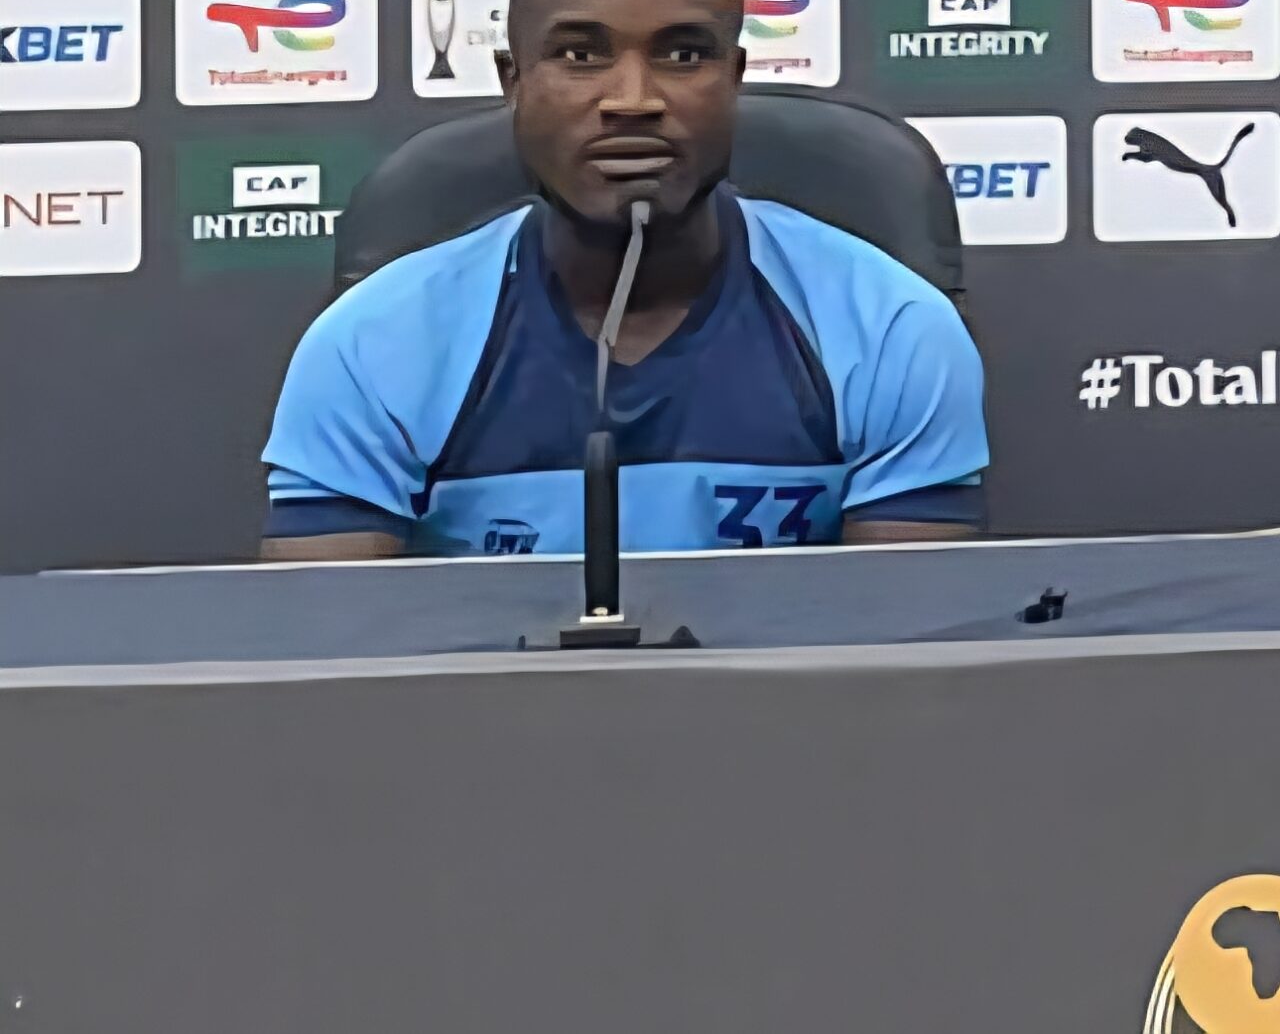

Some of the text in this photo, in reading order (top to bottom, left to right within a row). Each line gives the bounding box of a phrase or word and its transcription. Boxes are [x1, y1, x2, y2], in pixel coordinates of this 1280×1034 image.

[889, 30, 1050, 58] INTEGRITY
[246, 176, 308, 192] CAF
[944, 162, 1051, 198] BET
[192, 209, 346, 240] INTEGRIT
